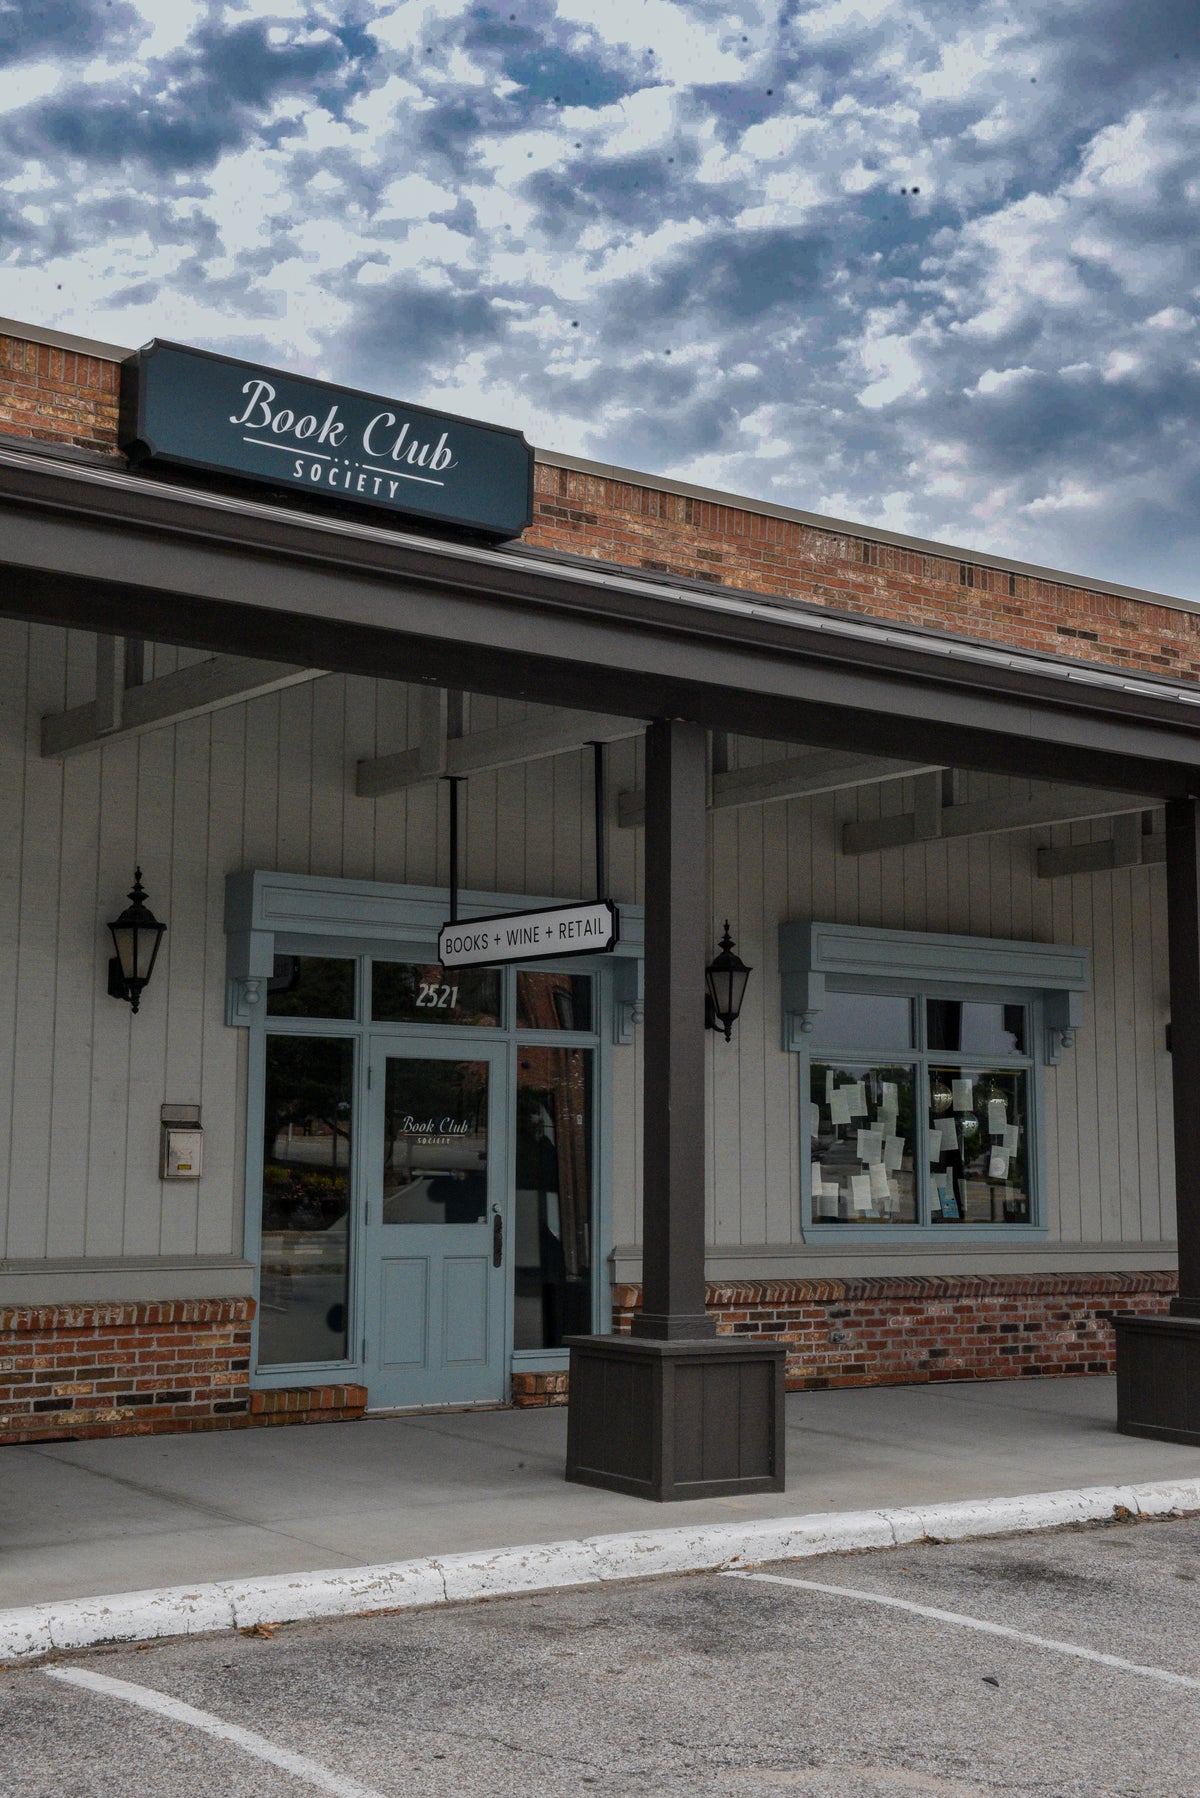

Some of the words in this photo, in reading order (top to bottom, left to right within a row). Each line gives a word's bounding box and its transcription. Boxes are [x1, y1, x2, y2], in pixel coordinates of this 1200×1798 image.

[229, 380, 347, 447] Book
[362, 412, 458, 470] Club
[293, 459, 399, 498] SOCIETY
[446, 933, 488, 954] BOOKS
[494, 933, 501, 945] +
[507, 926, 540, 946] WINE
[546, 926, 553, 938] +
[559, 918, 604, 940] RETAIL
[415, 983, 458, 1009] 2521
[401, 1115, 435, 1133] Book
[439, 1116, 469, 1133] Club
